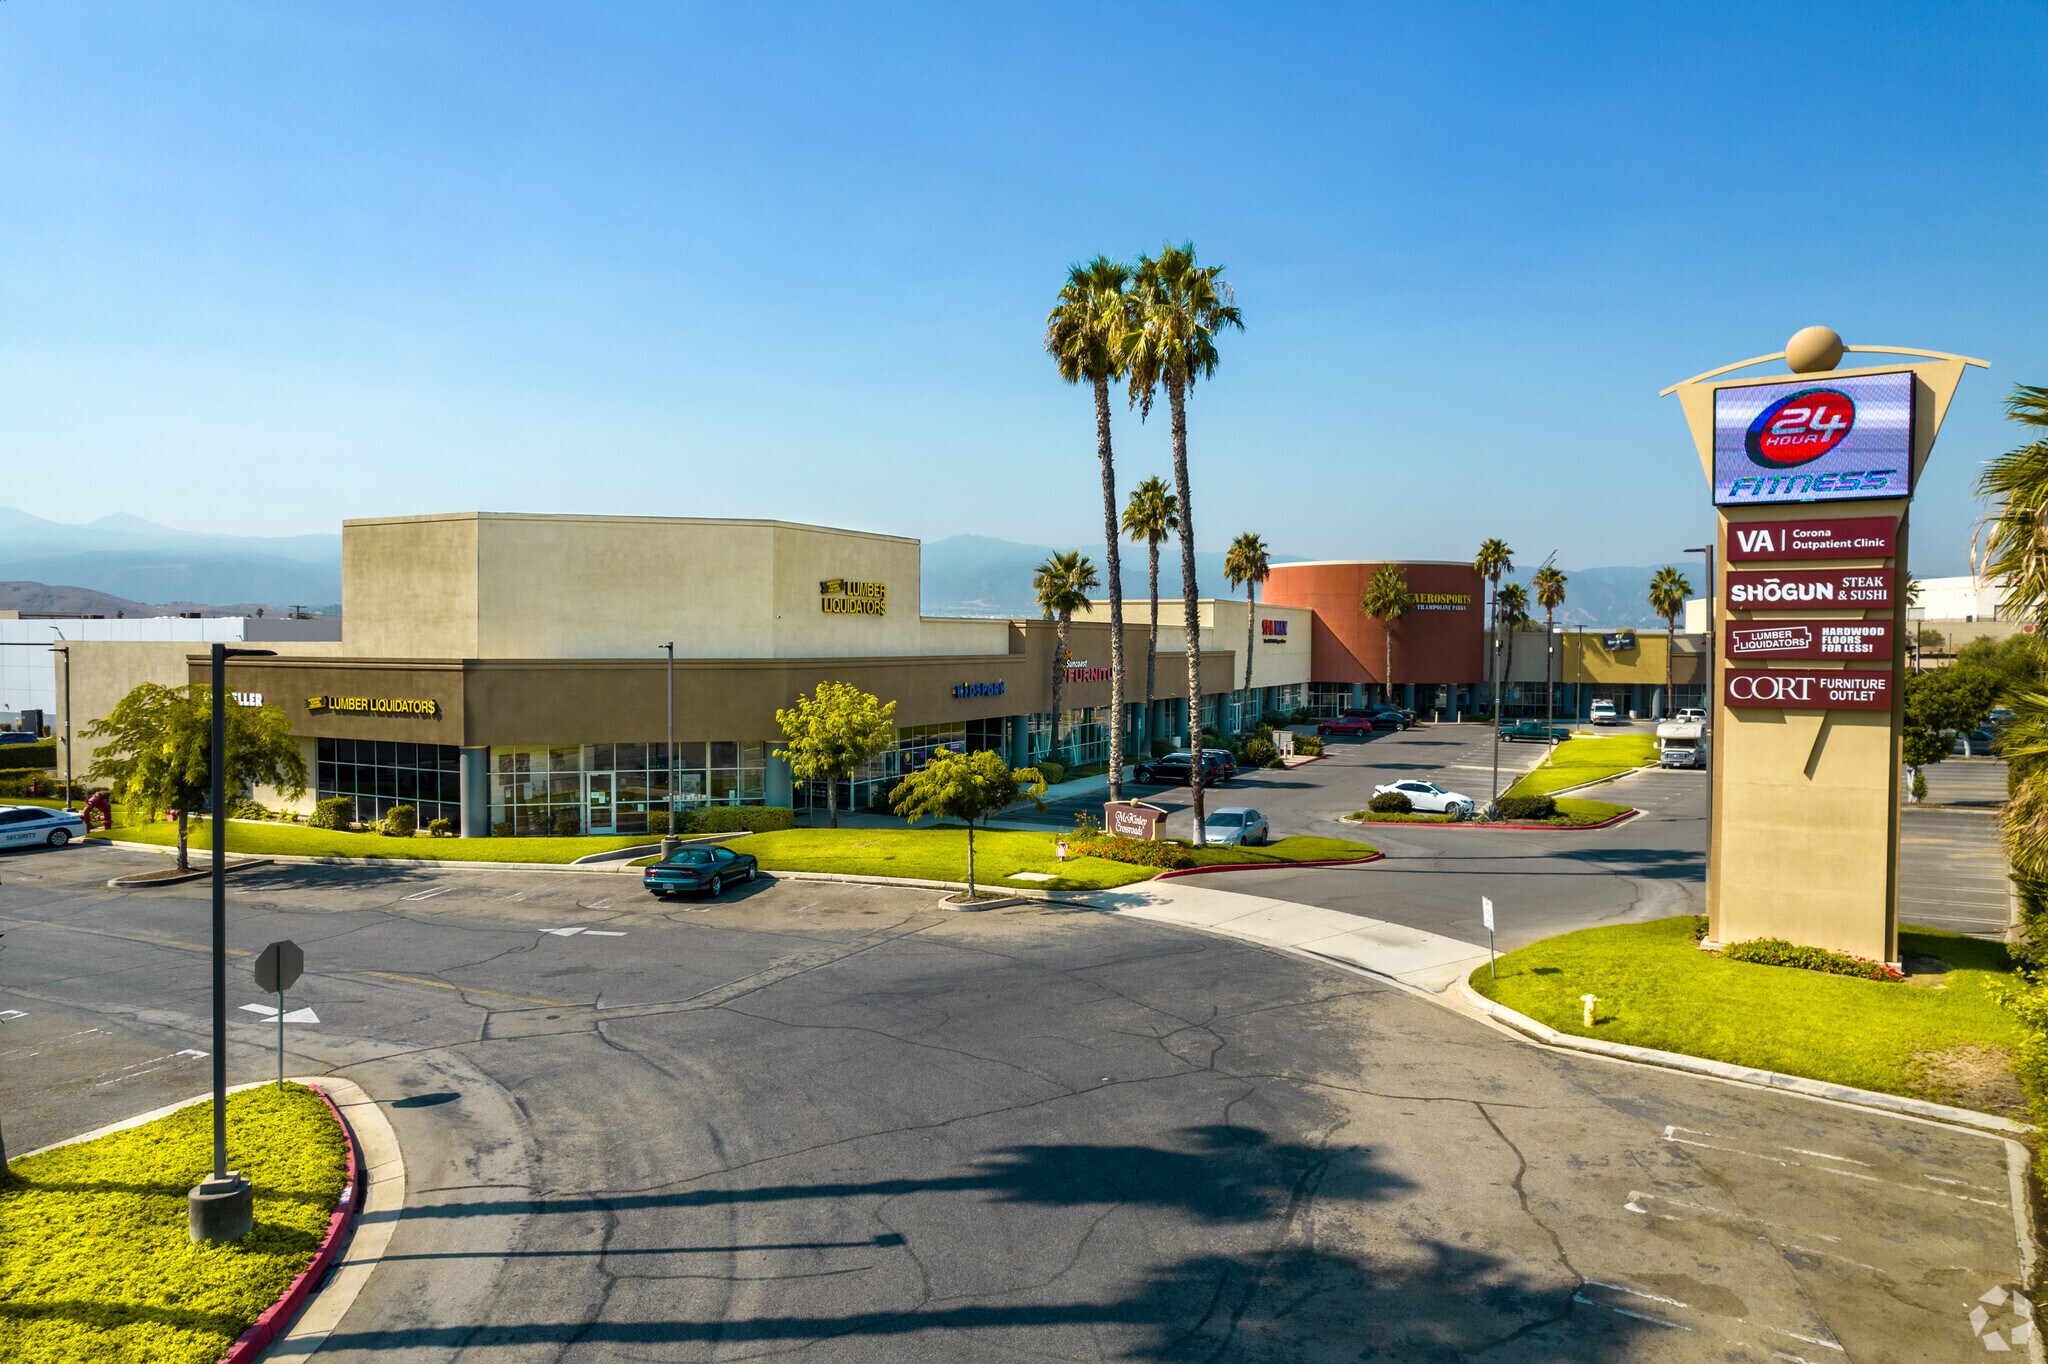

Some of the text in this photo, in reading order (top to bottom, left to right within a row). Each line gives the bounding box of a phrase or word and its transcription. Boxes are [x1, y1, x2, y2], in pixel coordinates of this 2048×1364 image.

[1773, 406, 1848, 443] 24
[1766, 434, 1818, 447] HOUR
[1729, 469, 1898, 497] FITNESS
[1793, 529, 1832, 538] Corona
[1737, 529, 1774, 553] VA
[1793, 538, 1885, 550] Outpatient Clinic
[1842, 576, 1884, 587] STEAK
[847, 582, 886, 597] LUMBER
[1838, 590, 1887, 600] & SUSHI
[1412, 592, 1472, 604] AEROSPORTS
[1751, 630, 1792, 640] LUMBER
[1821, 627, 1885, 636] HARDWOOD
[1740, 638, 1805, 650] LIQUIDATORS
[1821, 636, 1861, 644] FLOORS
[1821, 644, 1873, 653] FOR LESS!
[1066, 659, 1088, 668] Suncoast
[1067, 667, 1128, 682] FURNITUE
[1729, 675, 1816, 701] CORT
[1820, 678, 1886, 690] FURNITURE
[1829, 690, 1876, 701] OUTLET
[328, 697, 369, 711] LUMBER
[1115, 810, 1148, 829] McKinley
[1115, 821, 1143, 836] Crossroads
[6, 832, 36, 841] SECURITY
